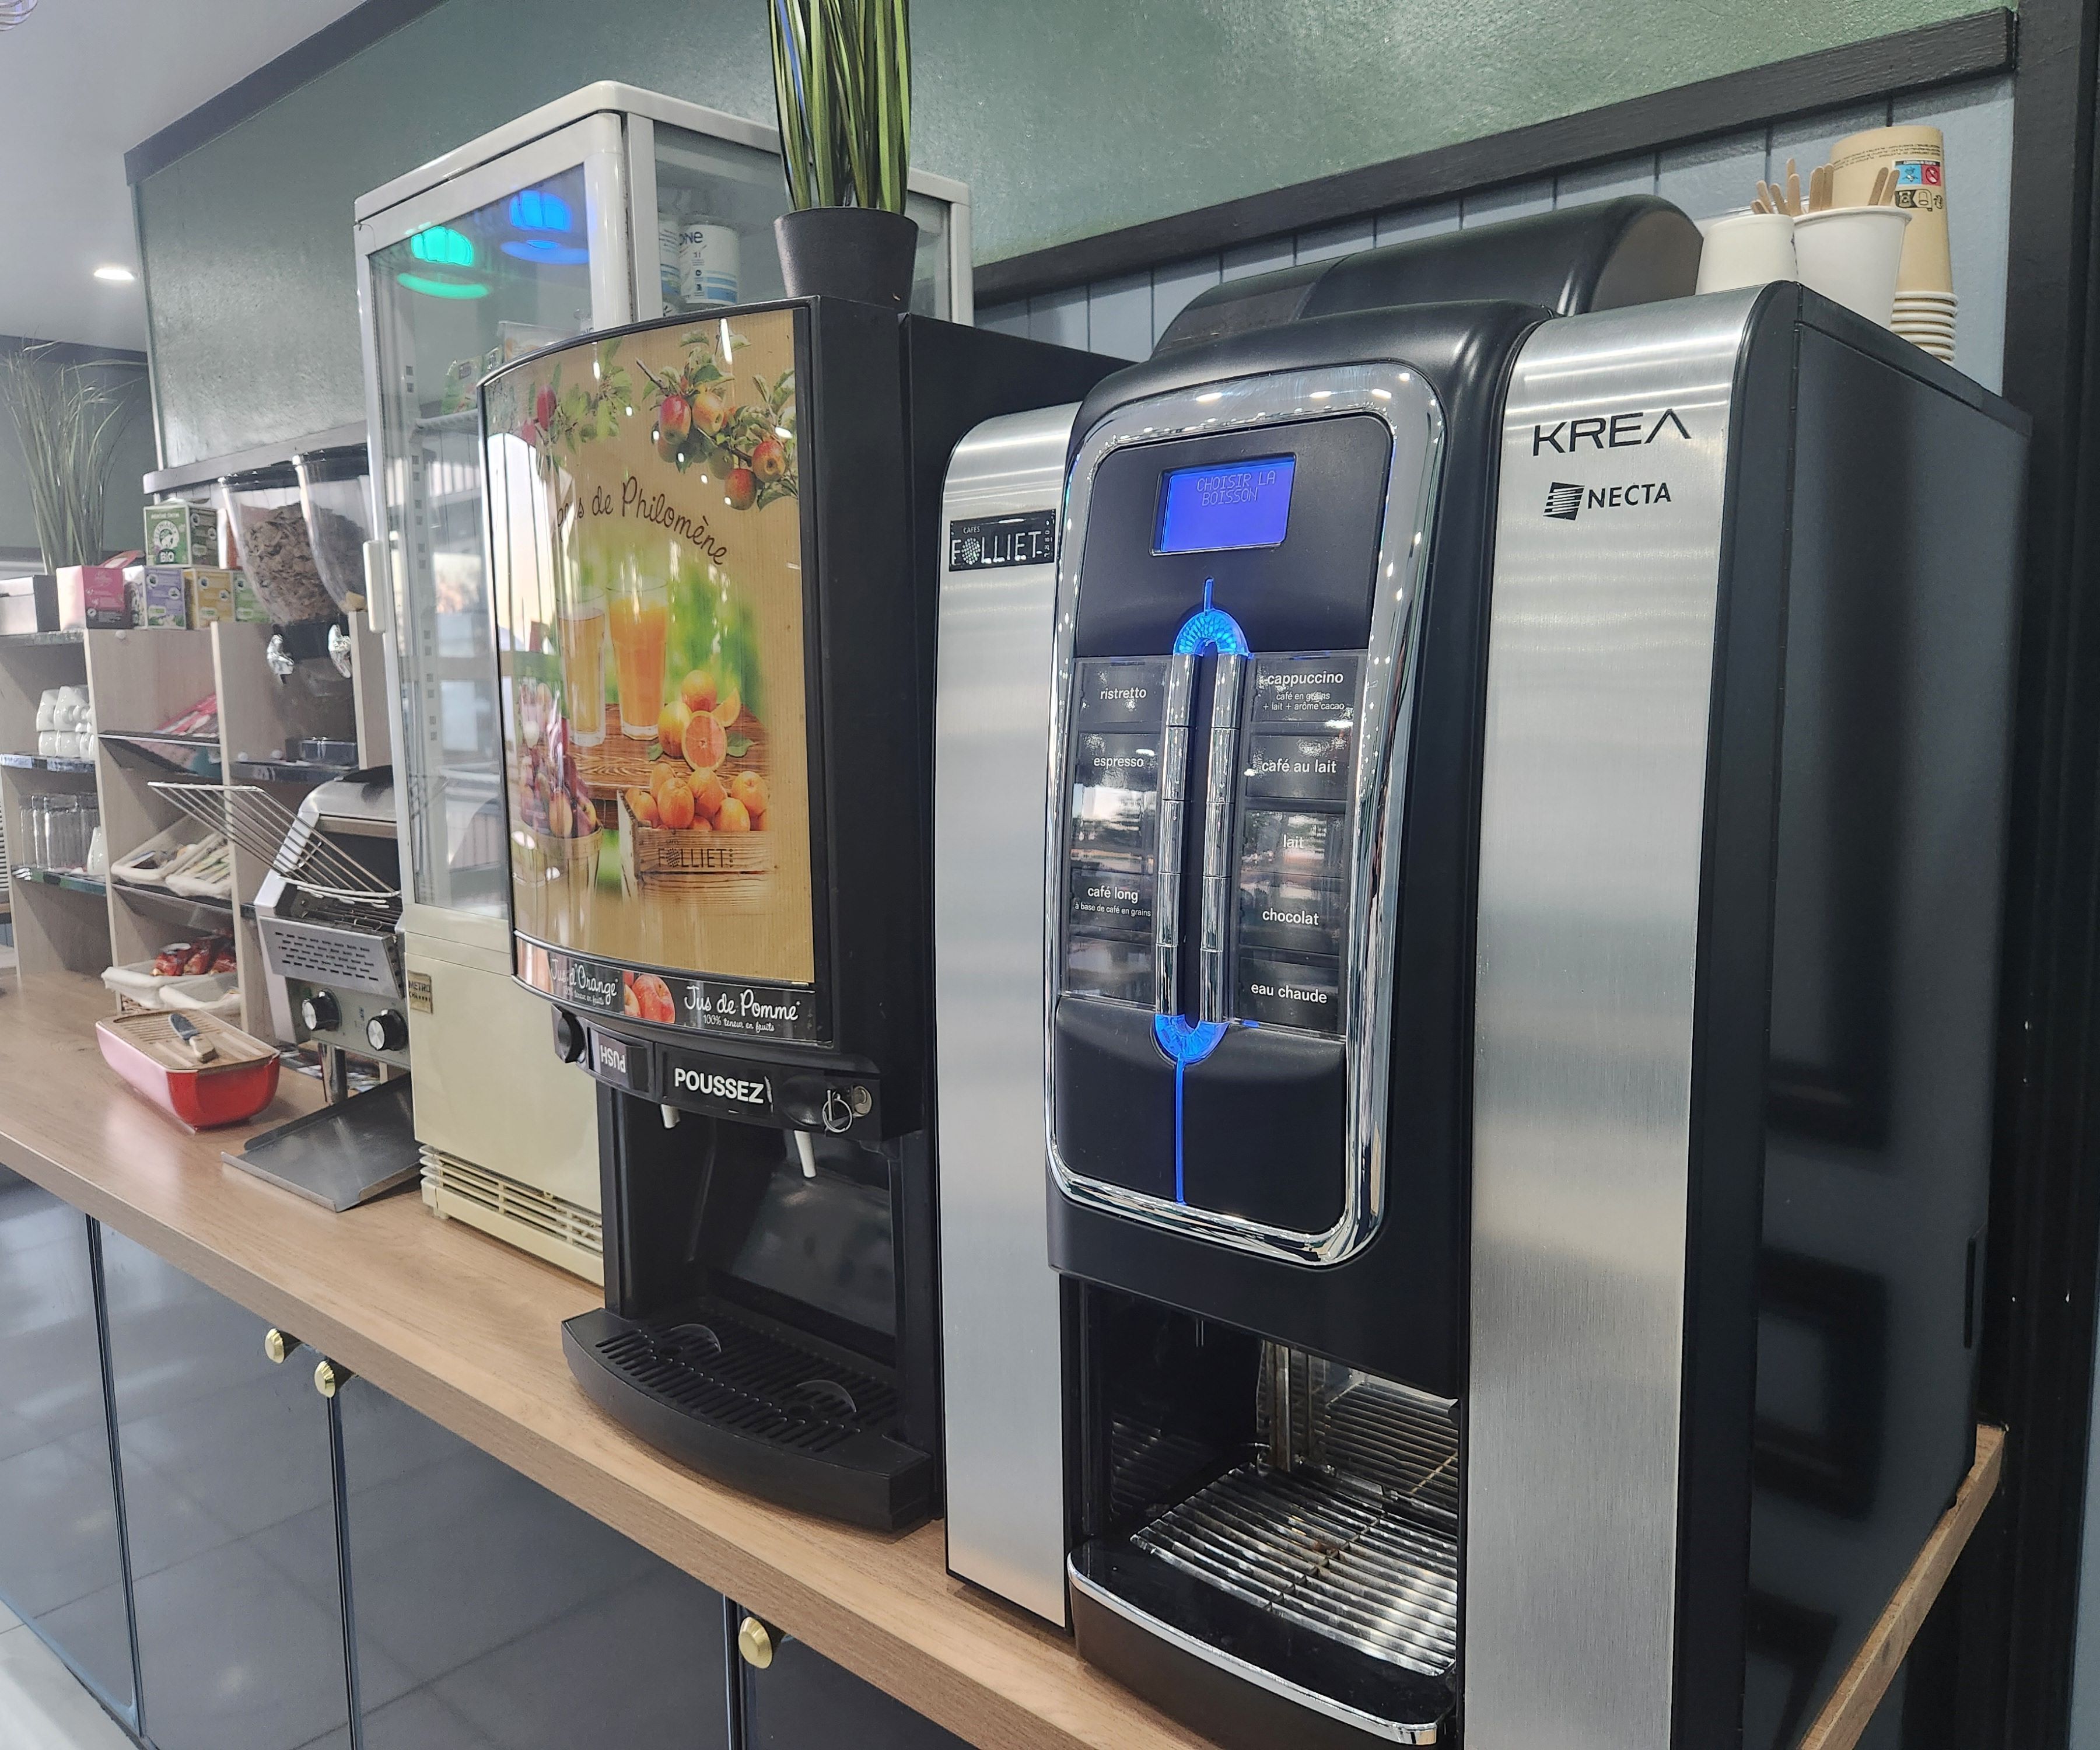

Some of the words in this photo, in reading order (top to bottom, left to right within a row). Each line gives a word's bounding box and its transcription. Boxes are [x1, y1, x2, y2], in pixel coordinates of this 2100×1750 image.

[1532, 408, 1692, 457] KREA
[1196, 473, 1252, 492] CHOISIR
[1258, 470, 1276, 486] LA
[1201, 487, 1258, 506] BOISSON
[1587, 482, 1672, 510] NECTA
[592, 485, 614, 516] de
[622, 475, 728, 566] Philomène
[1267, 670, 1344, 687] cappuccino
[1100, 687, 1147, 699] ristretto
[1276, 691, 1293, 701] café
[1271, 702, 1283, 710] lait
[1294, 701, 1319, 710] arôme
[1093, 757, 1144, 769] espresso
[1261, 758, 1290, 773] café
[1293, 762, 1310, 773] au
[1314, 758, 1337, 774] lait
[1283, 834, 1304, 849] lait
[1087, 885, 1111, 898] café
[1114, 886, 1139, 904] long
[1080, 902, 1096, 911] base
[1097, 904, 1105, 912] de
[1105, 905, 1120, 914] café
[1130, 908, 1152, 917] grains
[1262, 907, 1320, 925] chocolat
[684, 985, 712, 1012] Jus
[716, 993, 737, 1014] de
[1251, 984, 1274, 996] eau
[1278, 984, 1328, 1004] chaude
[702, 1013, 722, 1026] 100%
[723, 1017, 744, 1029] teneur
[755, 1020, 775, 1034] fruits
[599, 1044, 626, 1073] PUSH
[674, 1067, 765, 1104] POUSSEZ
